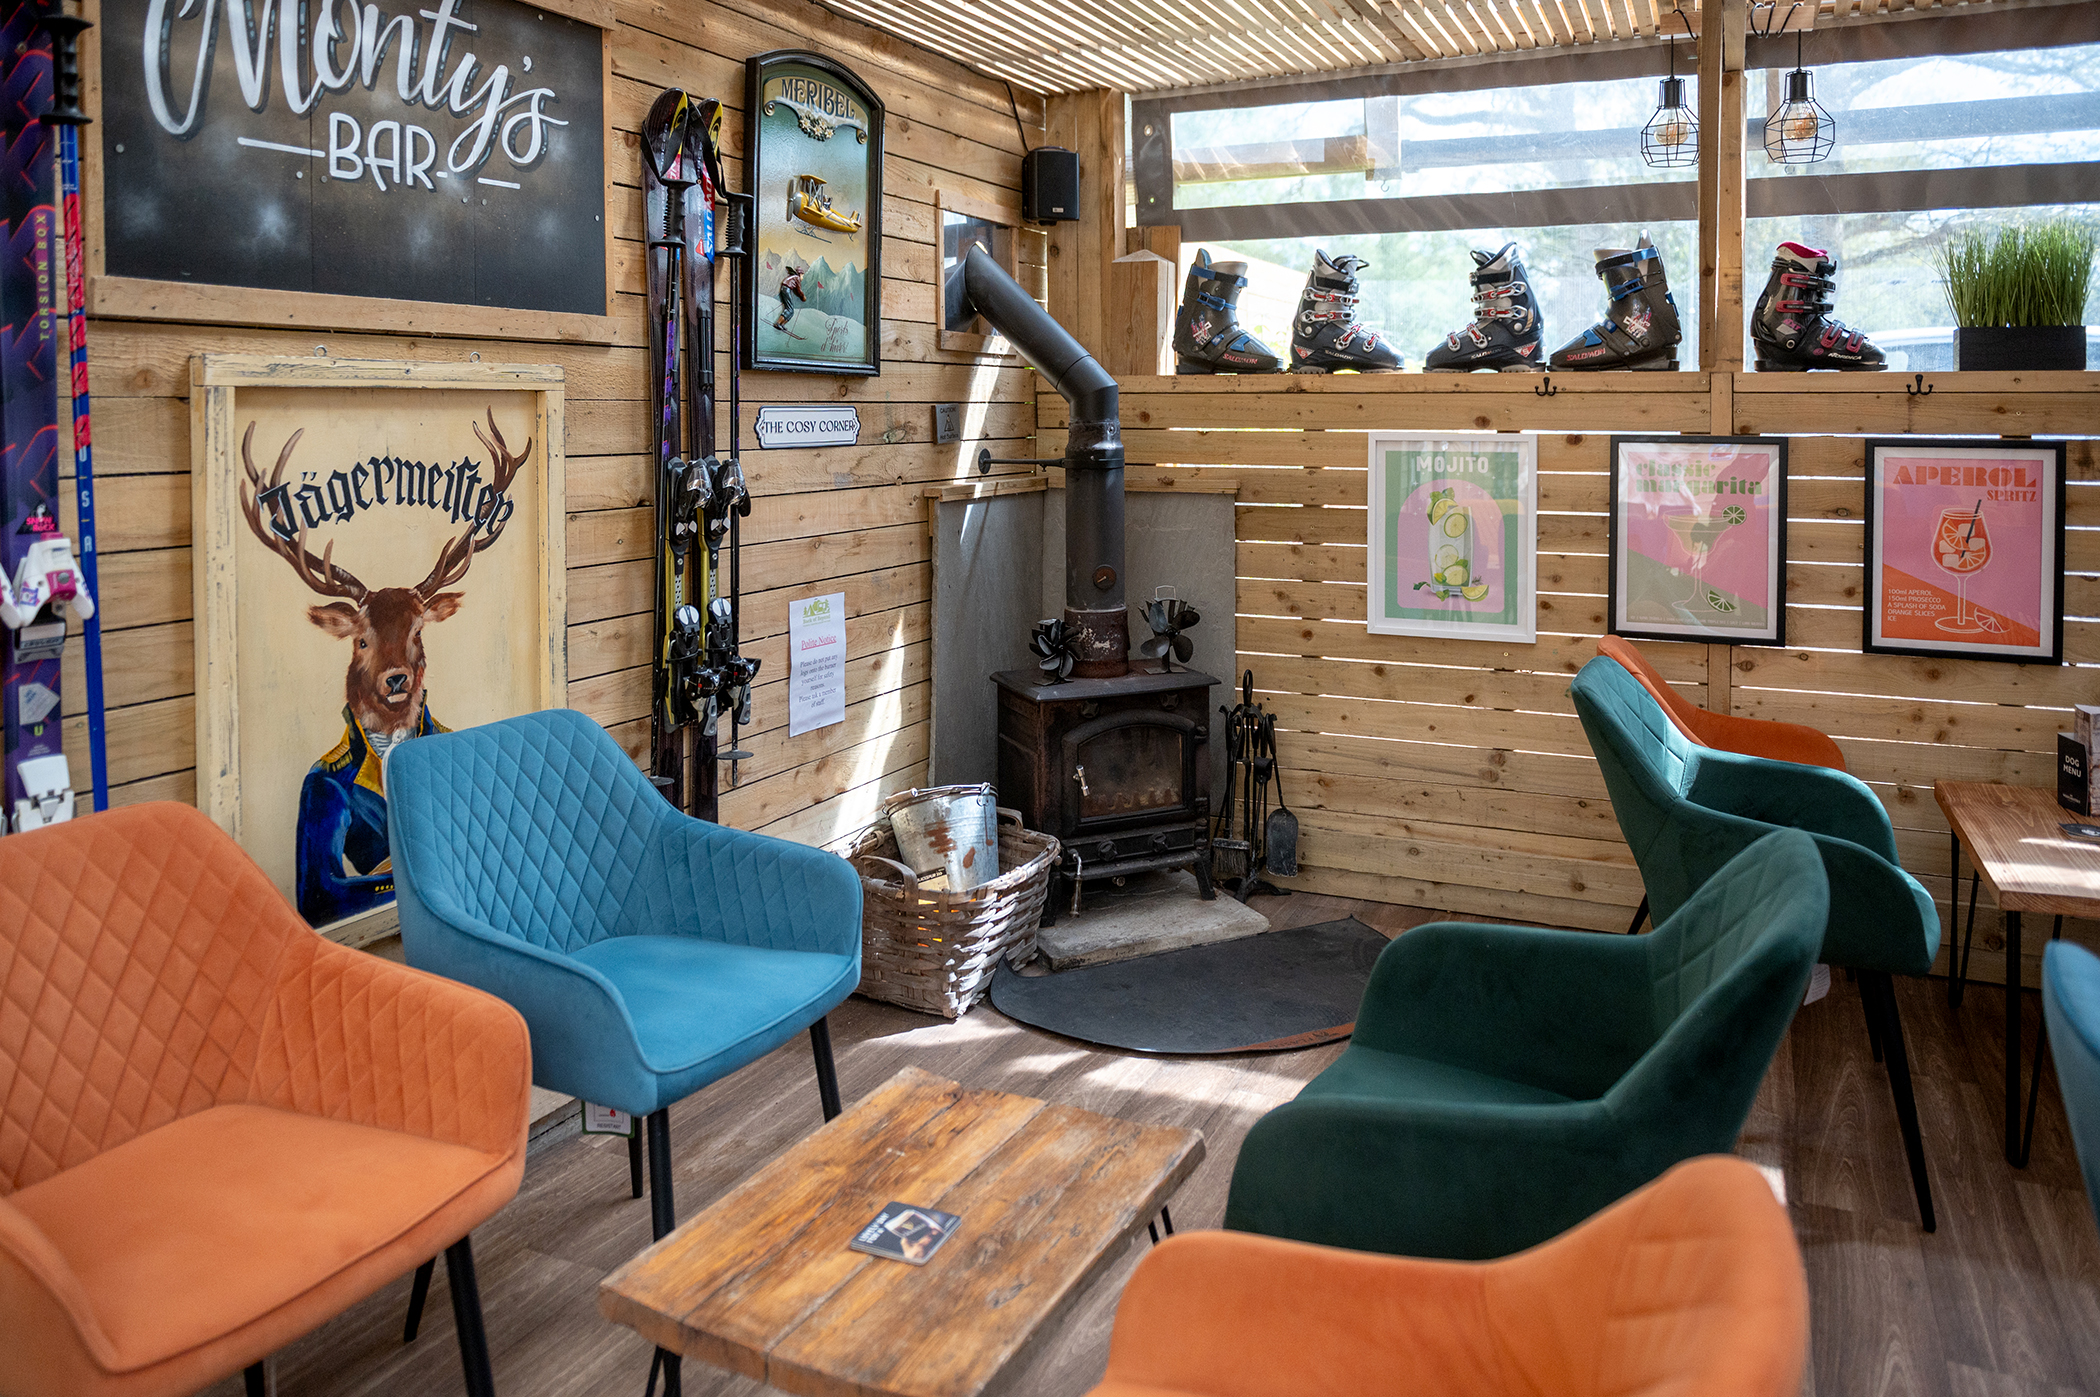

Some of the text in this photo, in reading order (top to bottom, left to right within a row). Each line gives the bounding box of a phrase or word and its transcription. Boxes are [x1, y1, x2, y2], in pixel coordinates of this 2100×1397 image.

[143, 0, 570, 166] Monty's
[781, 78, 856, 120] MERIBEL
[328, 112, 437, 192] BAR
[36, 214, 50, 341] TORSION BOX
[1222, 353, 1259, 365] SALOMON
[1566, 347, 1606, 361] SALOMON
[763, 418, 855, 434] THE COSY CORNER
[1416, 455, 1490, 474] MOJITO
[1635, 459, 1716, 478] classic
[1892, 465, 2037, 488] APEROL
[1635, 476, 1763, 497] margarita
[1986, 489, 2037, 502] SPRITZ
[801, 633, 837, 649] Polite Notice
[2063, 763, 2082, 778] MENU
[2064, 754, 2080, 768] DOG
